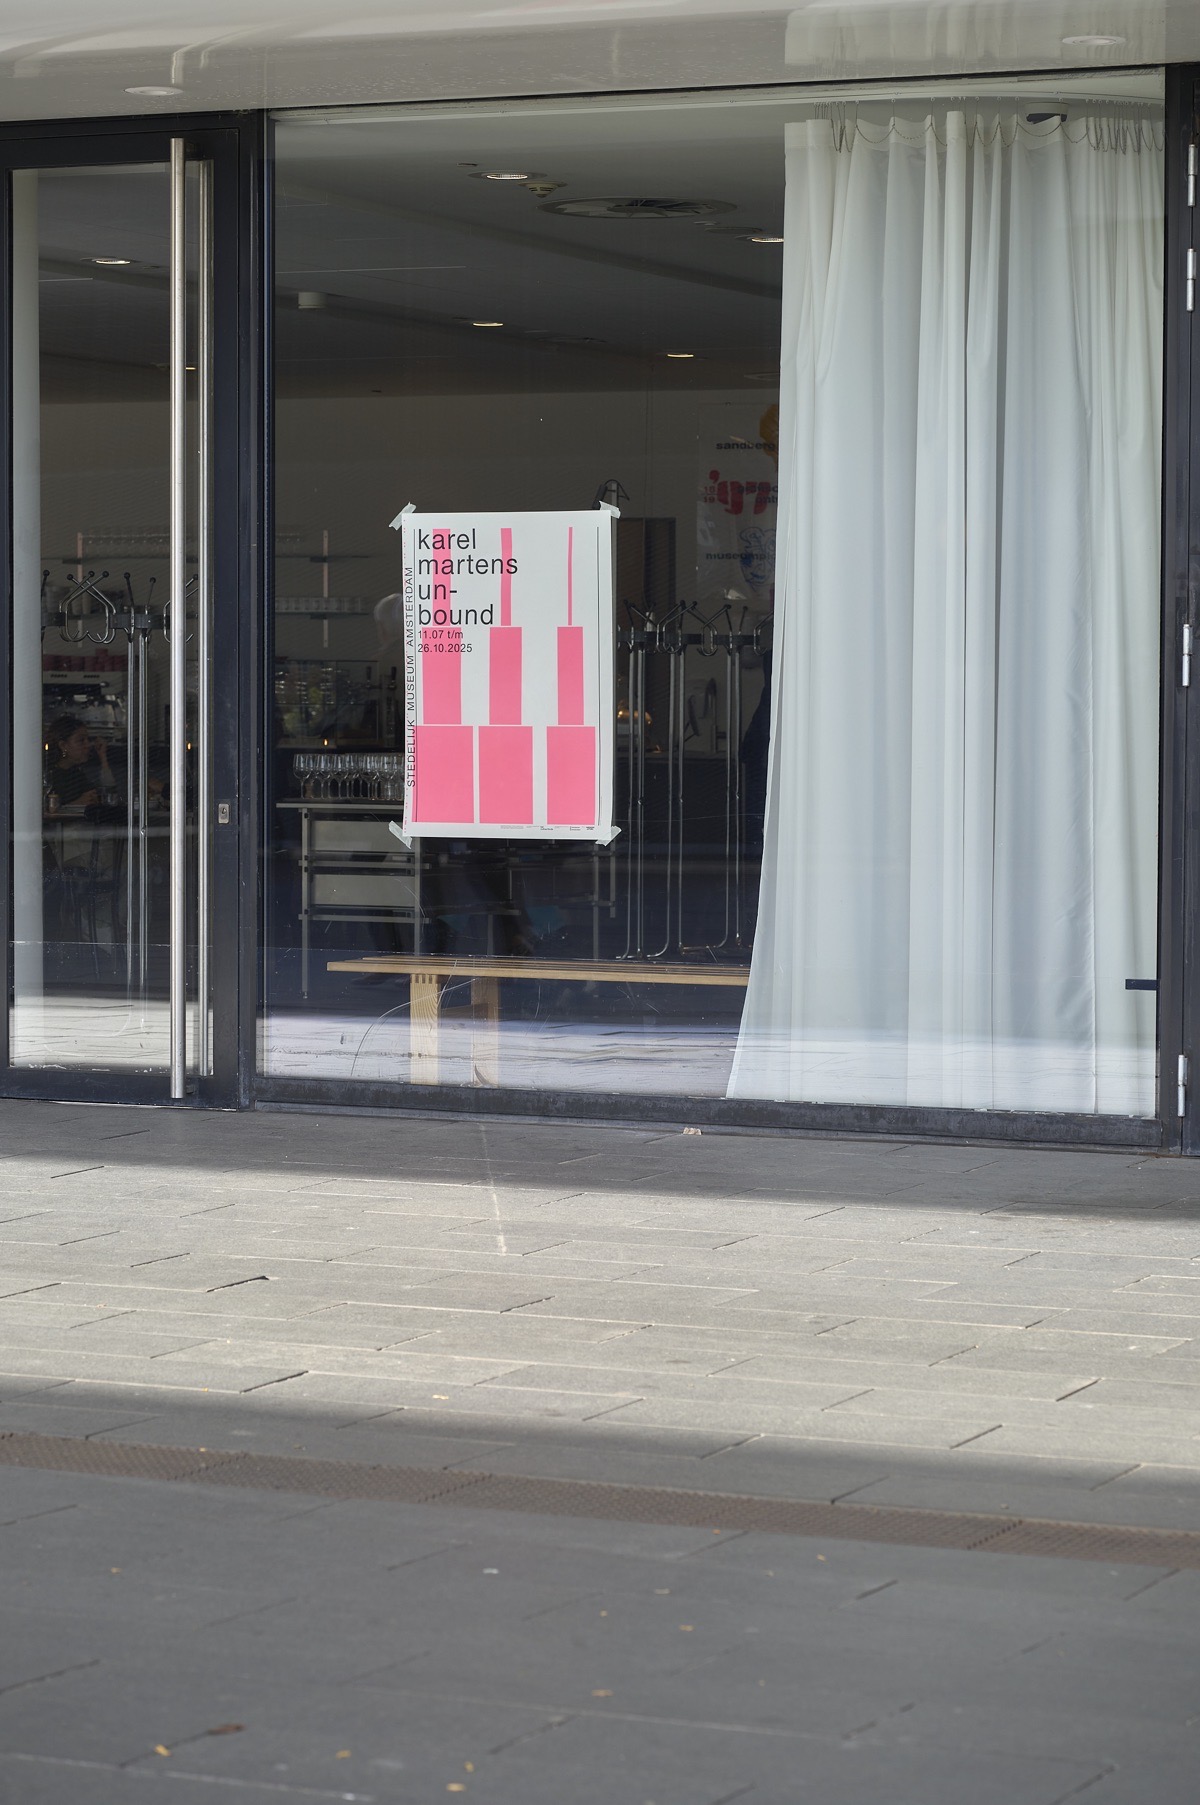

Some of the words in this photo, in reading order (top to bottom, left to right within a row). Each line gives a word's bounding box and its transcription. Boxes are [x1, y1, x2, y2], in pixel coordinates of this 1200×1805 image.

[716, 440, 776, 452] sandberg
[418, 528, 476, 550] karel
[418, 554, 518, 575] martens
[418, 584, 458, 600] un-
[404, 567, 414, 647] AMSTERDAM
[418, 603, 493, 625] bound
[418, 629, 444, 639] 11.07
[447, 629, 464, 639] t/m
[417, 643, 473, 653] 26.10.2025
[406, 655, 415, 711] MUSEUM
[407, 719, 416, 787] STEDELIJK
